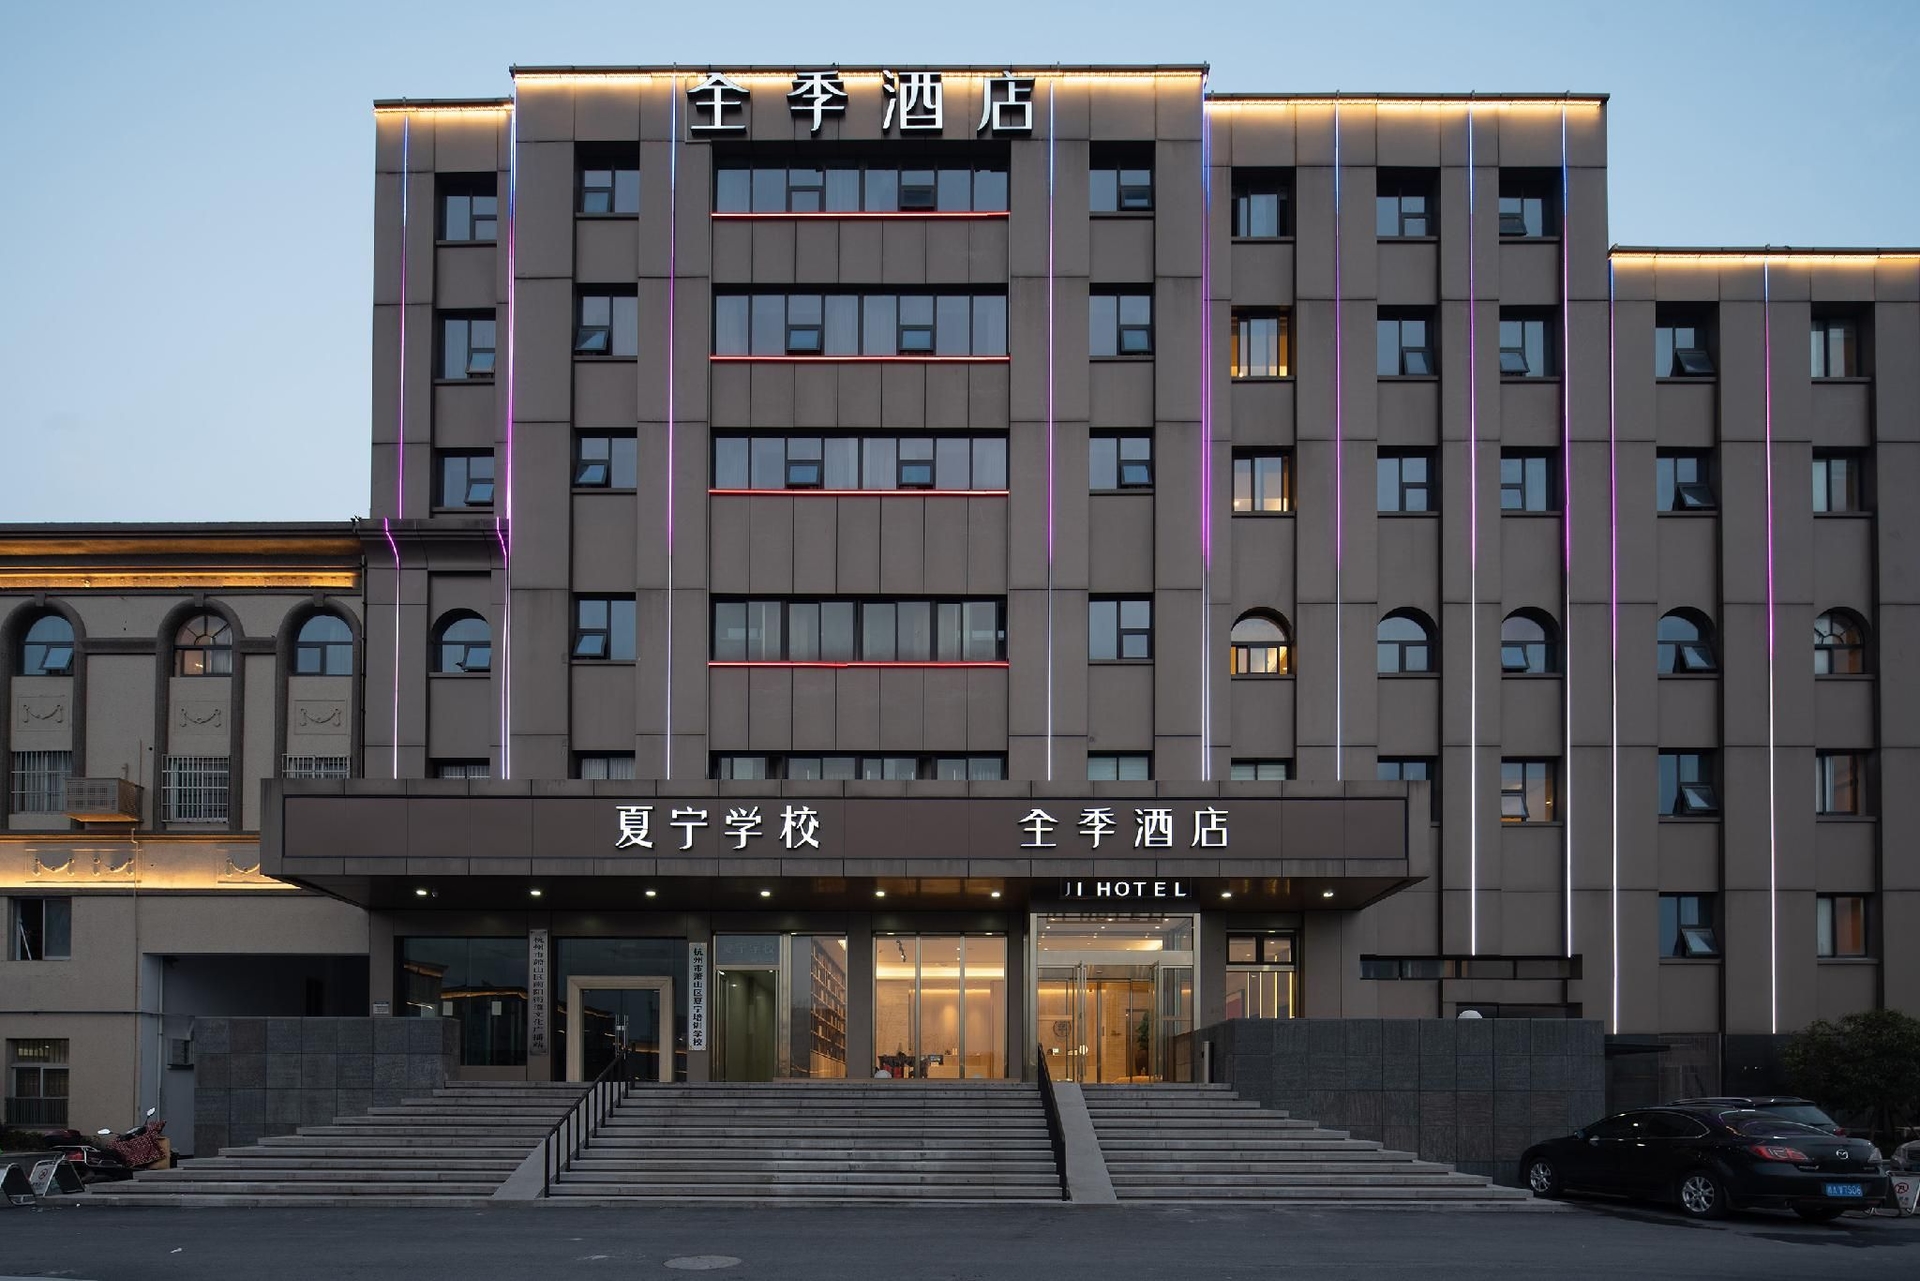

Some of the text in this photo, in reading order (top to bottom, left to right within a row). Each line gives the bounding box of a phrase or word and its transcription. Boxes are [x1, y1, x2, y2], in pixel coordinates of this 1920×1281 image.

[686, 70, 1035, 135] 全季酒店
[615, 805, 820, 850] 夏宁学校
[1018, 806, 1229, 849] 全季酒店
[1065, 881, 1187, 897] JI HOTEL
